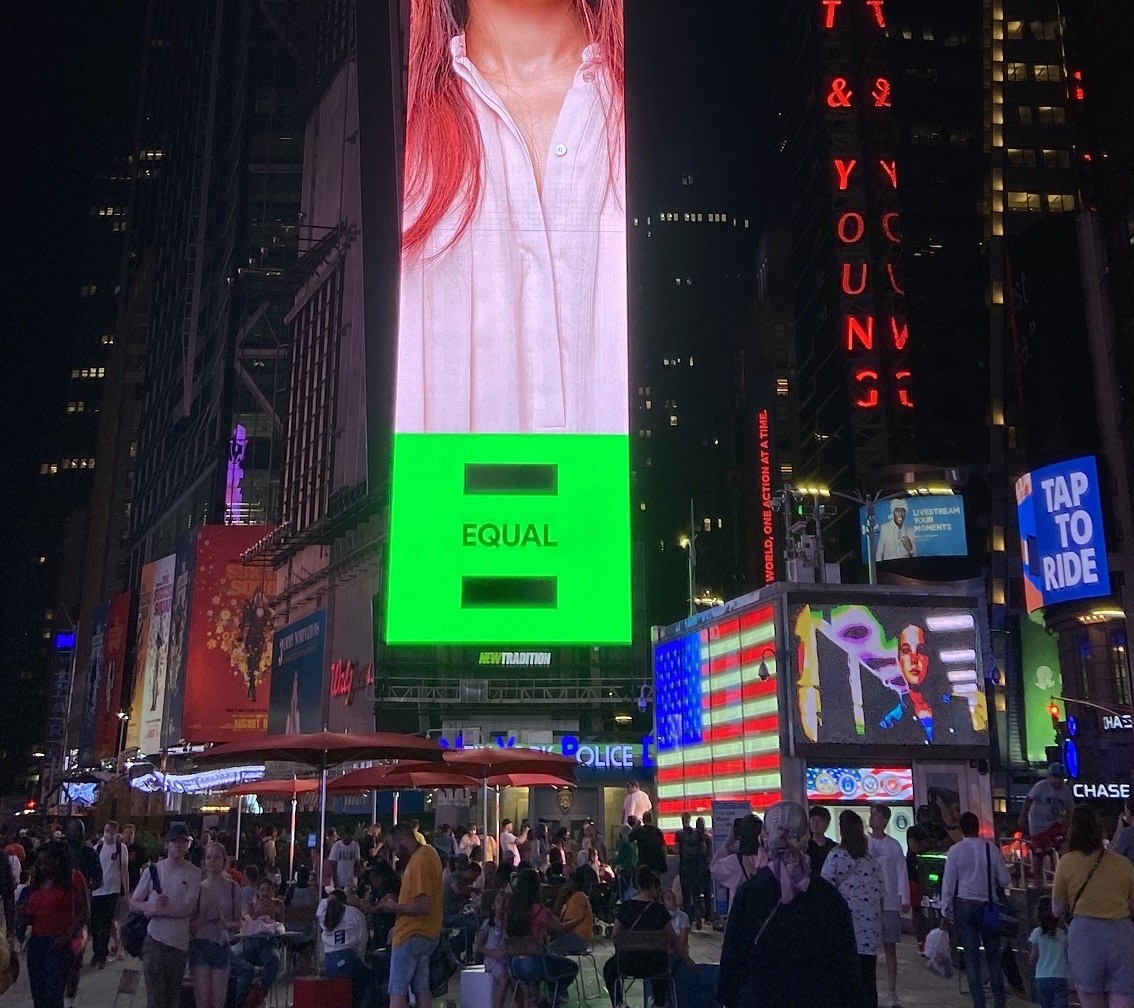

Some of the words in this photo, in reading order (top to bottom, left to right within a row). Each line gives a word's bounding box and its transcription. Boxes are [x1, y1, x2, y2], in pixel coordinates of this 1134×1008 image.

[761, 467, 772, 508] ACTION
[1041, 471, 1089, 513] TAP
[762, 509, 772, 535] ONE
[912, 506, 961, 517] LIVESTREAM
[461, 522, 560, 549] EQUAL
[913, 523, 952, 533] MOMENTS
[1054, 509, 1093, 548] TO
[1042, 547, 1099, 592] RIDE
[561, 735, 634, 768] POLICE
[1073, 784, 1130, 798] CHASE
